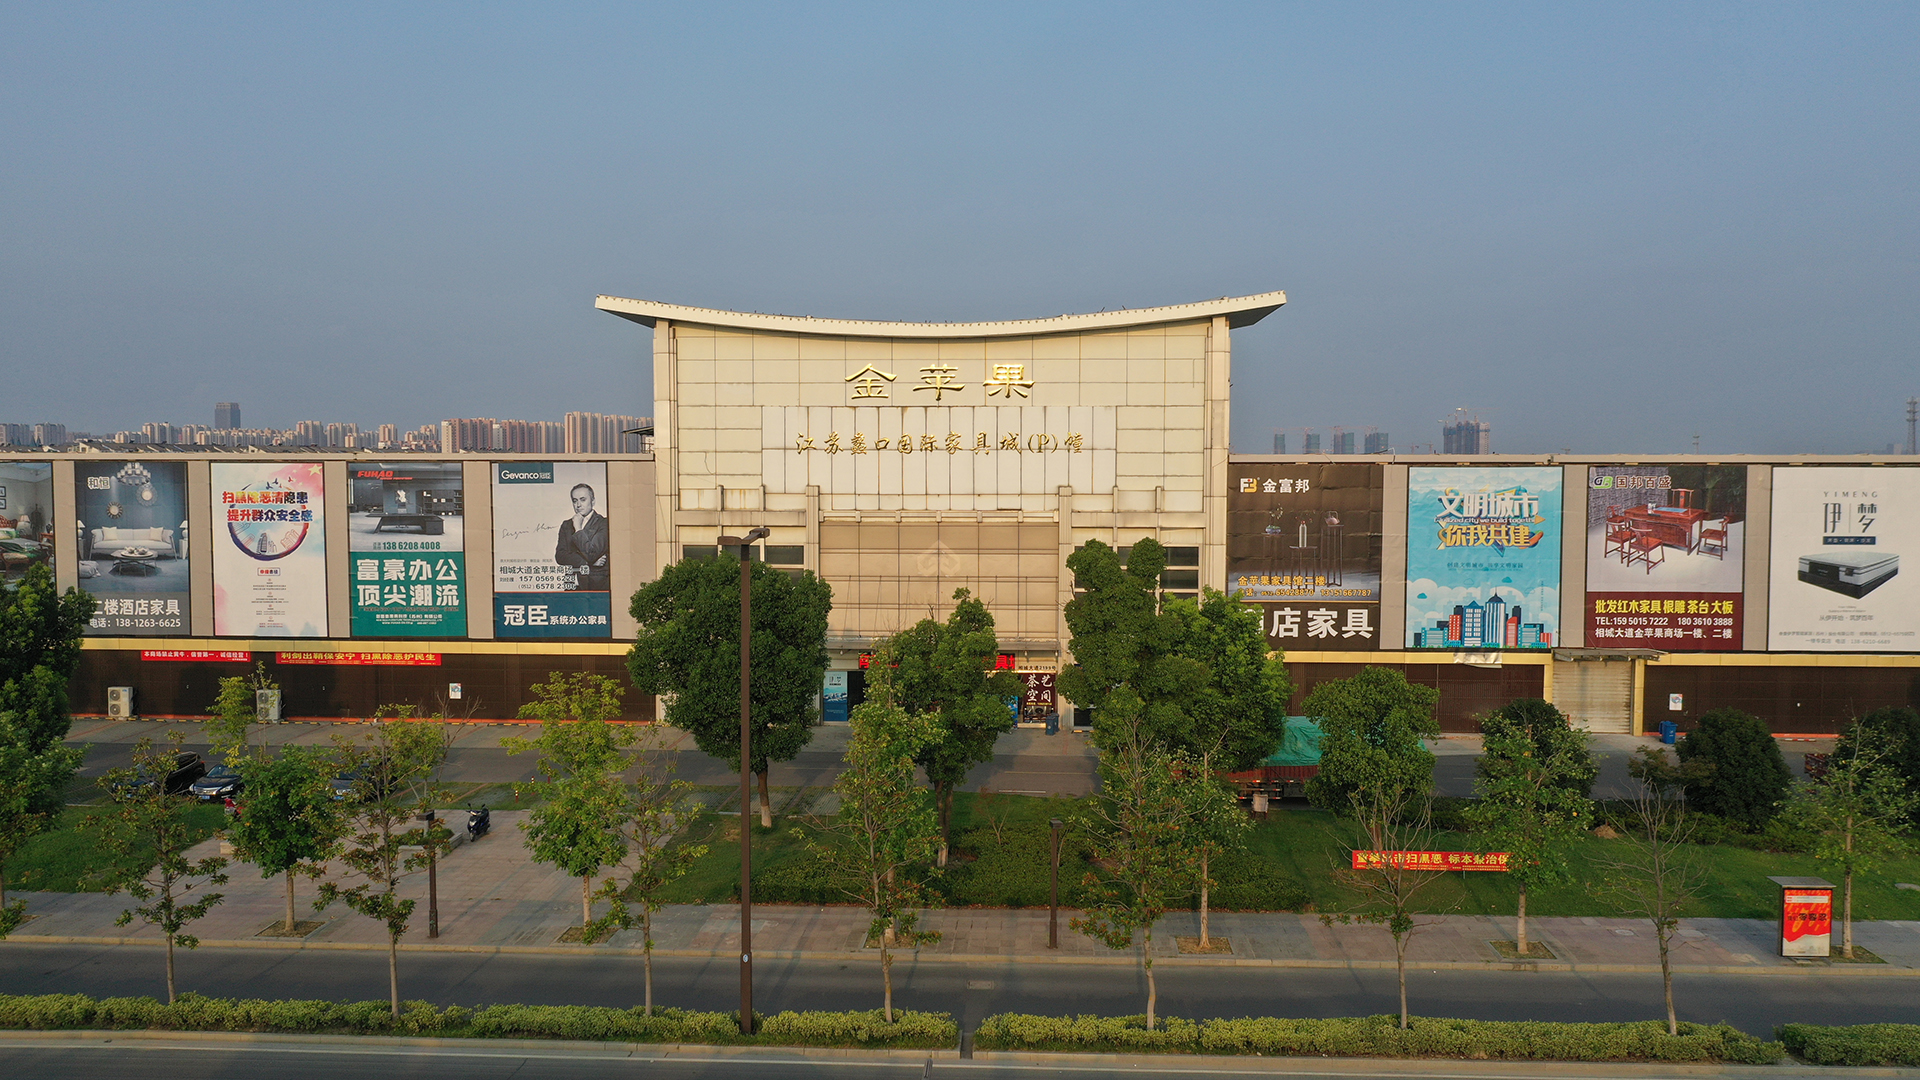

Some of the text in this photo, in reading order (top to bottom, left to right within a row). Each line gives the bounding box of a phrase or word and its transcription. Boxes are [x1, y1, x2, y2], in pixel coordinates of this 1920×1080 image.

[845, 363, 1035, 401] 金苹果
[357, 470, 394, 479] FUHAO
[501, 470, 539, 480] Gevanco
[88, 477, 110, 489] 和恒
[1262, 478, 1310, 493] 金富邦
[1615, 475, 1672, 490] 国邦百盛
[222, 491, 308, 504] 扫黑除恶清隐患
[1436, 492, 1539, 518] 文明城市
[227, 509, 313, 521] 提升群众安全感
[1445, 524, 1531, 547] 你我共建
[382, 541, 397, 550] 138
[398, 541, 419, 550] 6208
[420, 541, 441, 550] 4008
[356, 559, 458, 581] 富豪办公
[499, 565, 590, 575] 相城大道金苹果商场一楼
[1237, 575, 1327, 586] 金苹果家具馆二楼
[356, 584, 460, 606] 顶尖潮流
[91, 599, 181, 616] 二楼酒店家具
[1595, 600, 1662, 614] 批发红木家具
[1687, 600, 1709, 614] 茶台
[1710, 600, 1733, 614] 大板
[503, 605, 607, 626] 冠臣 系统办公家具
[1628, 617, 1648, 625] 5015
[1649, 617, 1669, 625] 7222
[1677, 617, 1692, 625] 180
[1692, 617, 1712, 625] 3610
[1713, 617, 1733, 625] 3888
[1595, 628, 1733, 639] 相城大道金苹果商场一楼、二楼
